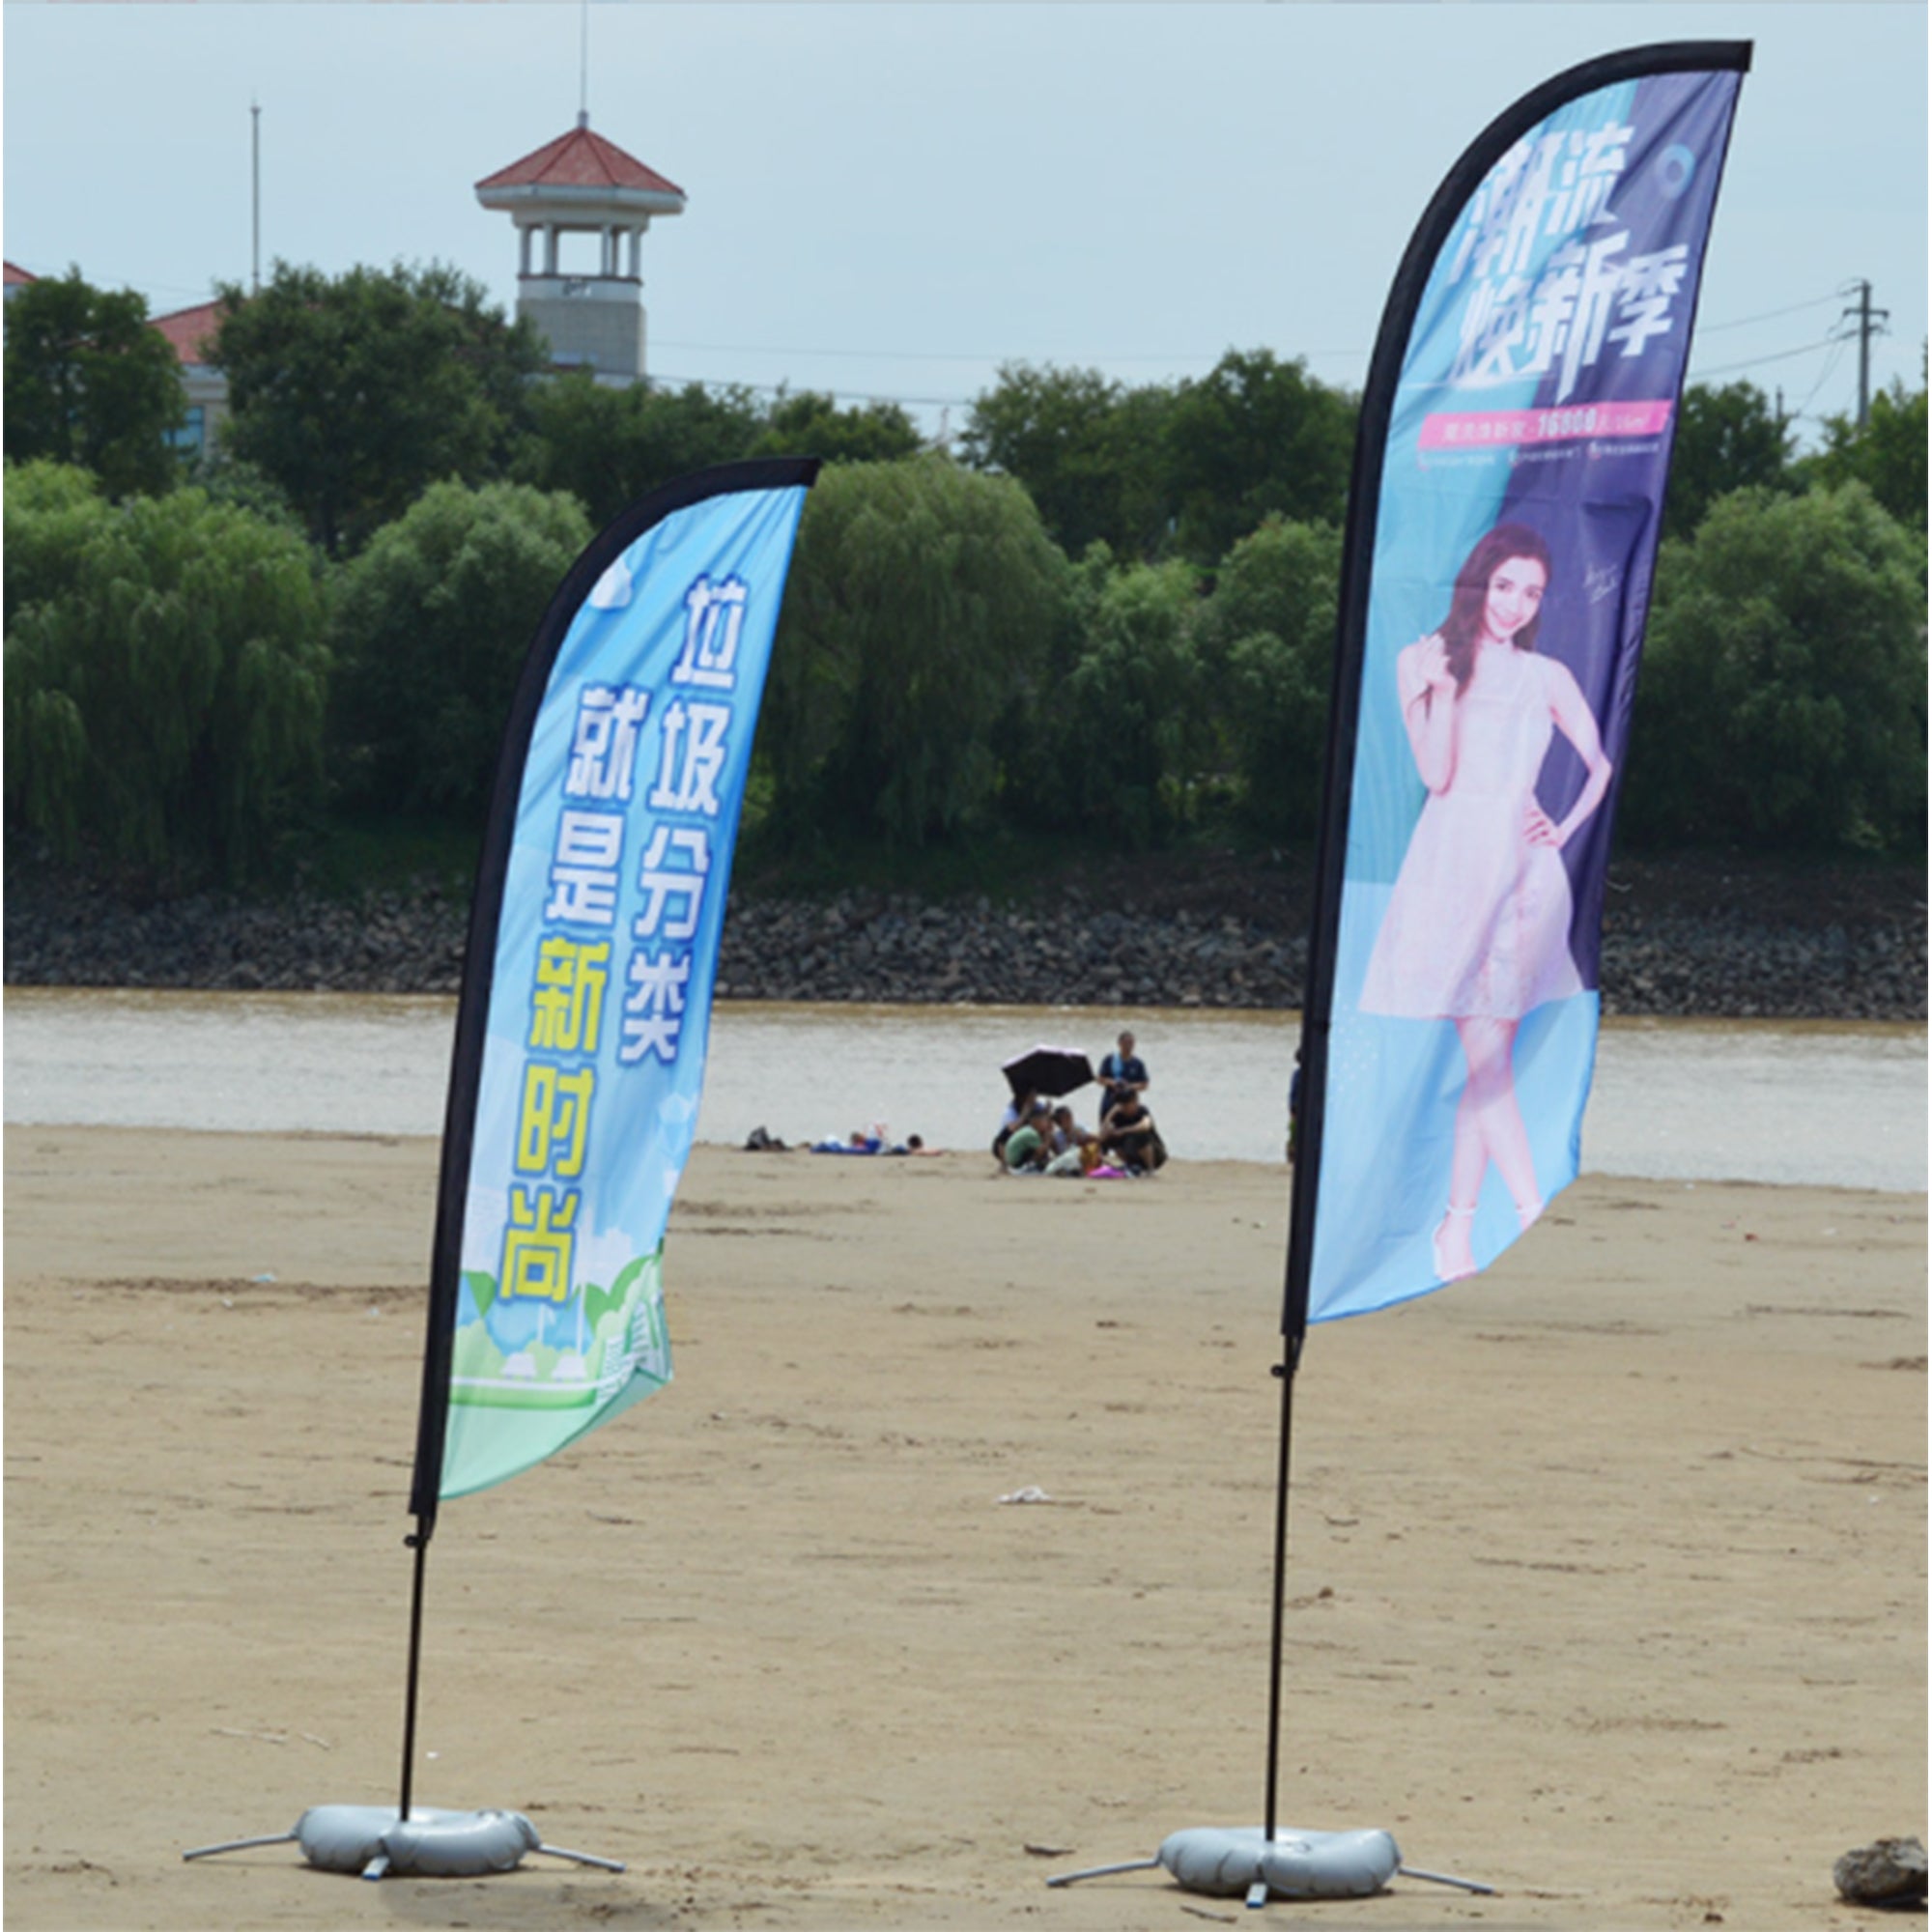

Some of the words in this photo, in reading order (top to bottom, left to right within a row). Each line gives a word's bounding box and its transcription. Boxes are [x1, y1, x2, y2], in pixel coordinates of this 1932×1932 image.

[499, 686, 649, 1303] 就是新时尚
[619, 577, 748, 1062] 垃圾分类
